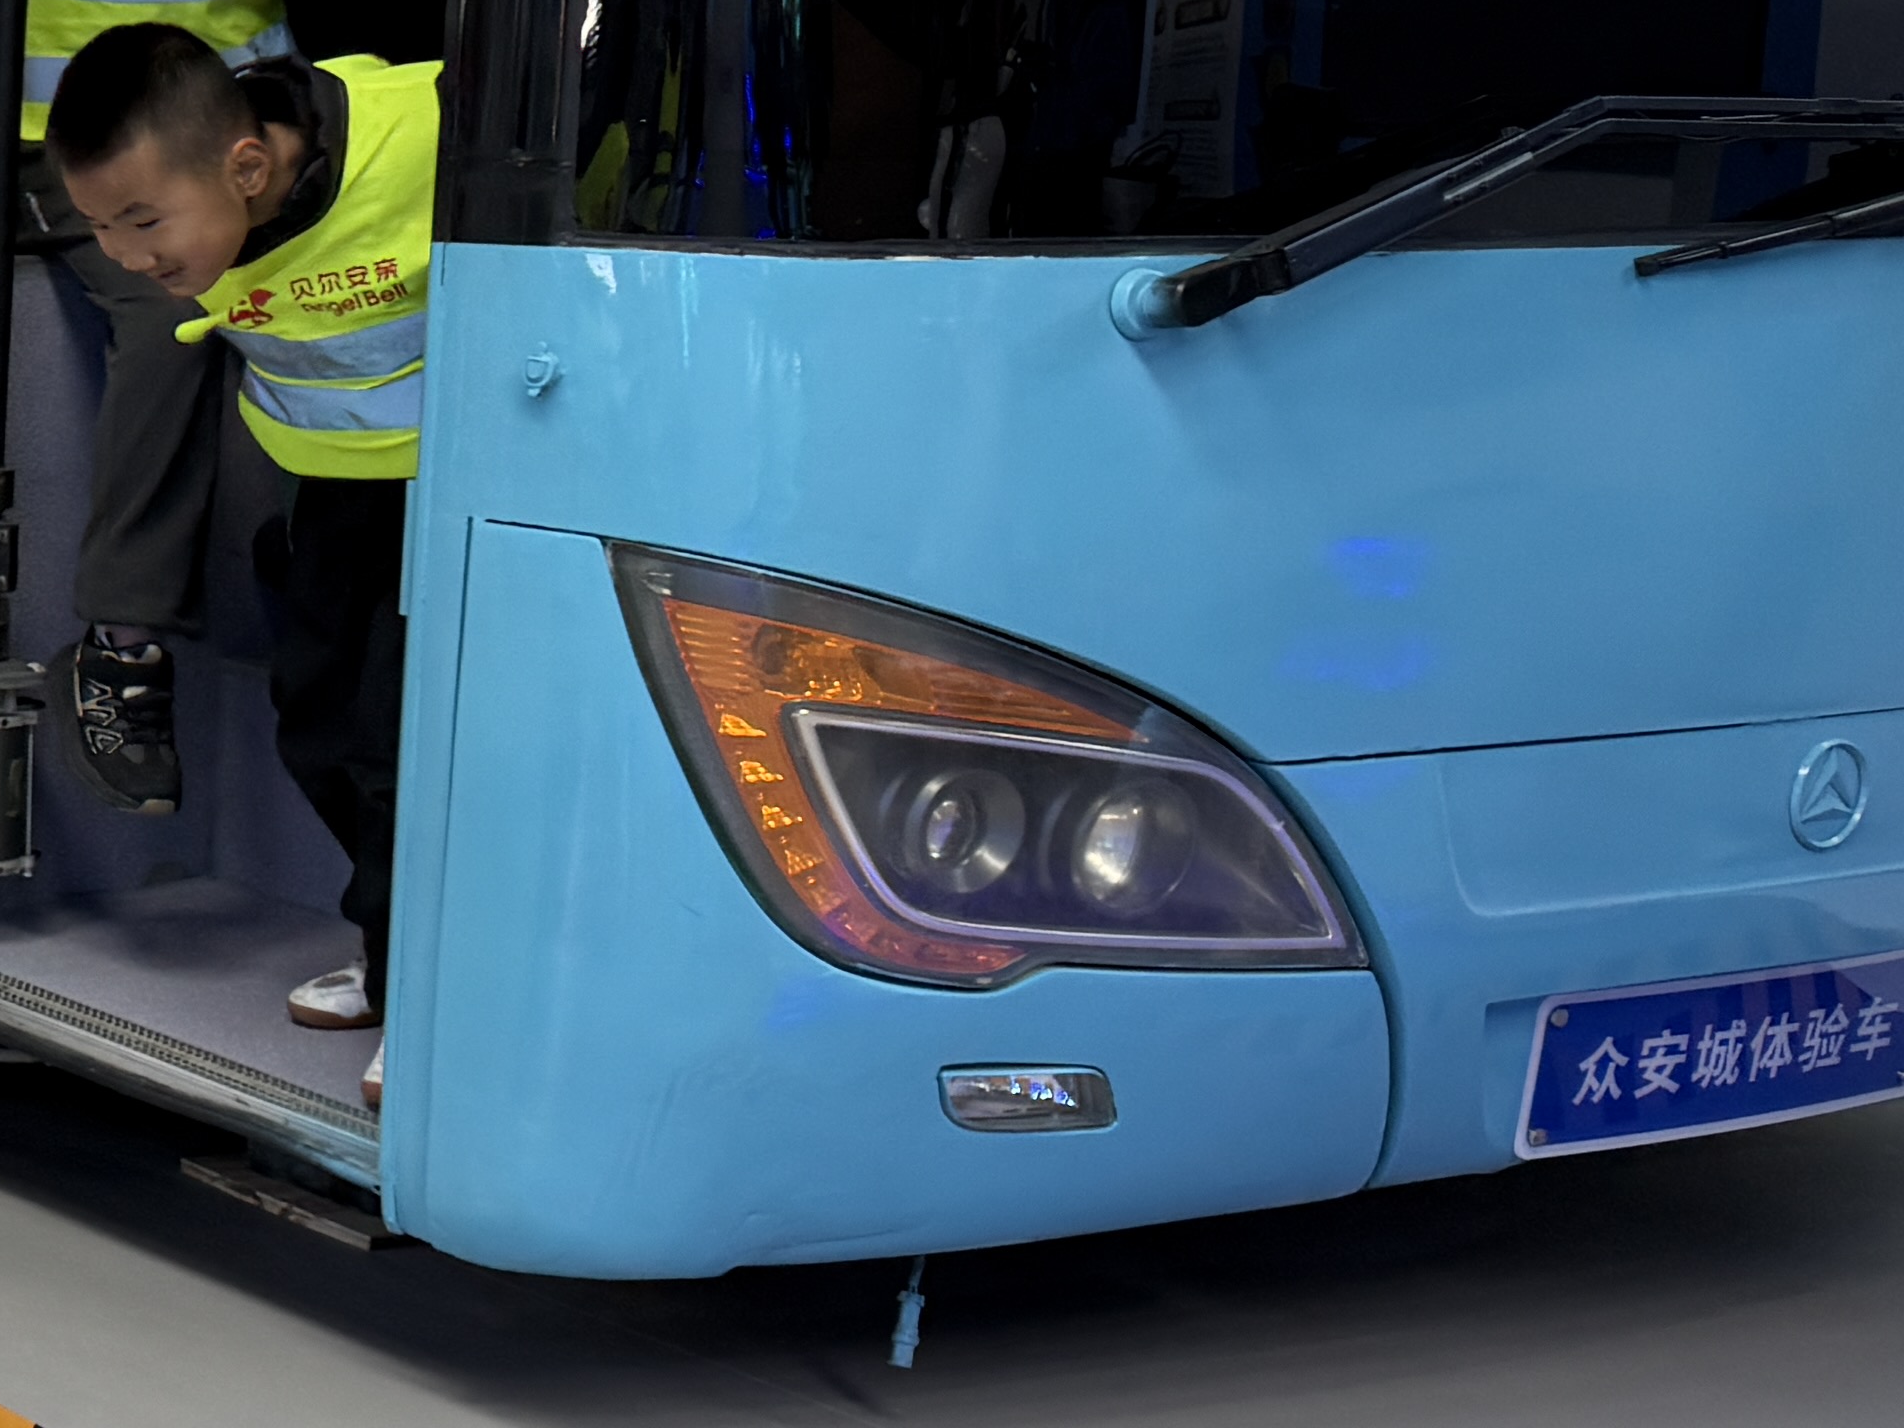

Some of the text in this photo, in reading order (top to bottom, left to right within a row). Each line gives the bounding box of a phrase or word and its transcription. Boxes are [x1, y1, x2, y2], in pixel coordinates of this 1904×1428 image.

[363, 281, 409, 308] Bell
[1571, 996, 1900, 1106] 众安城体验车
